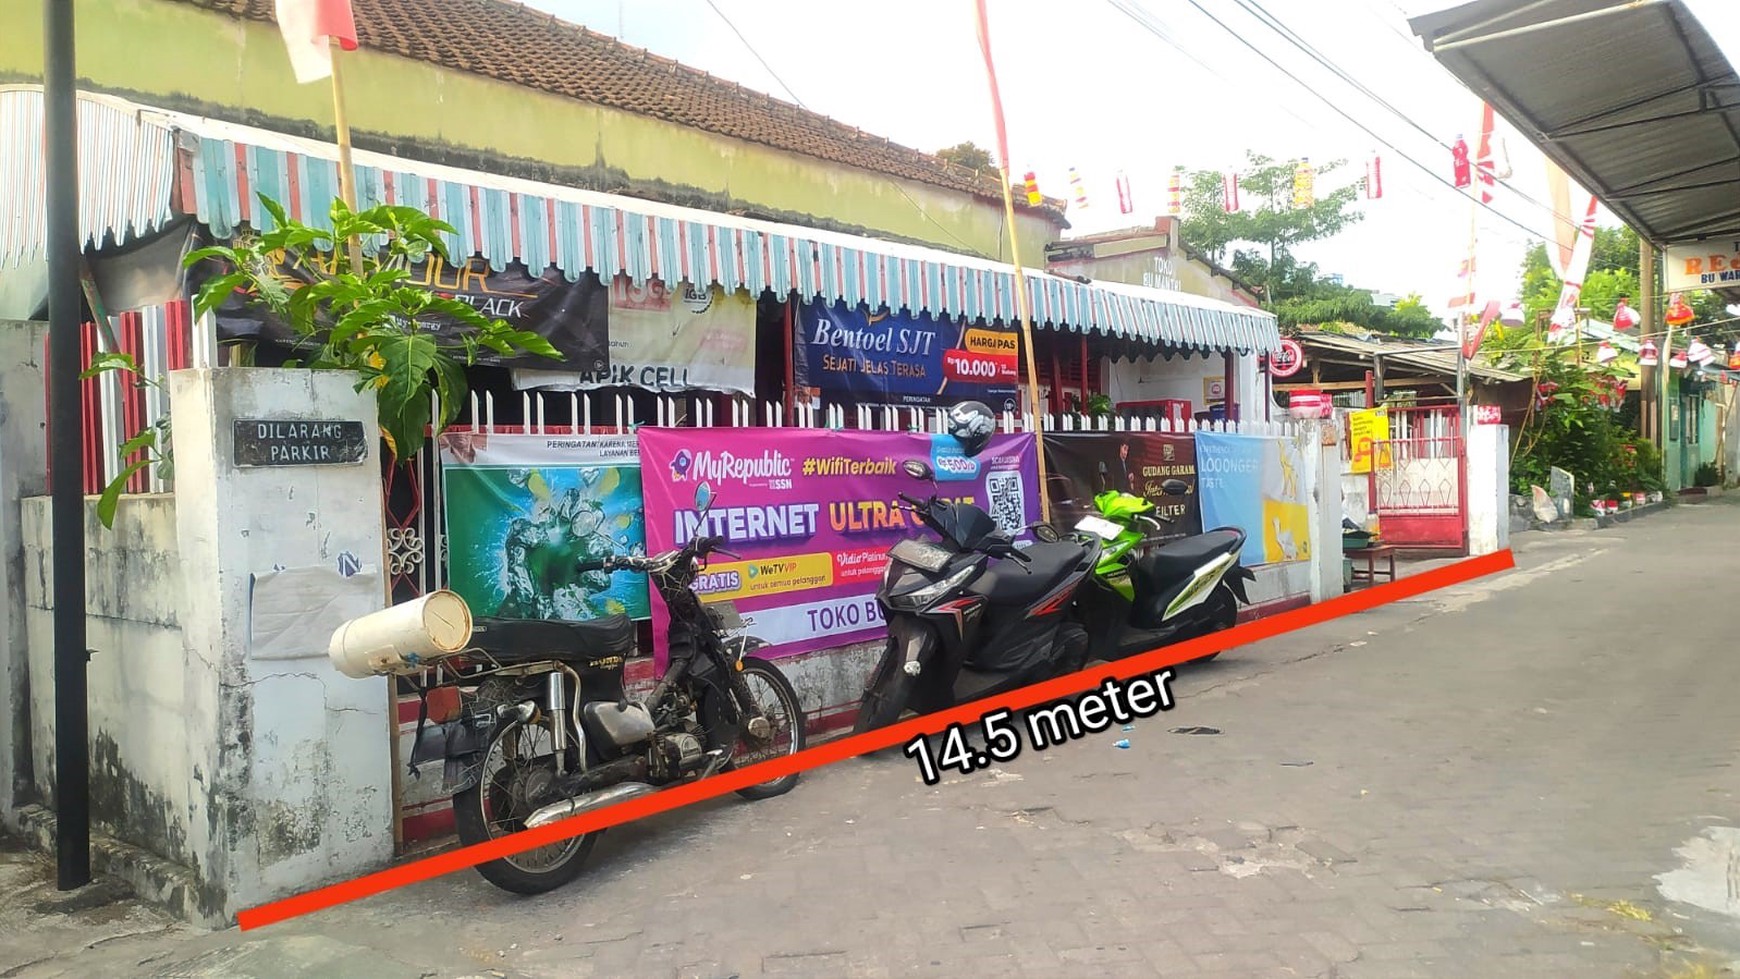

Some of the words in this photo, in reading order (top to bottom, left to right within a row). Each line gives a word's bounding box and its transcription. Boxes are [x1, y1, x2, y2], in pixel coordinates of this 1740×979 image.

[1153, 256, 1174, 276] TOKO
[1701, 273, 1715, 283] BU
[810, 318, 893, 352] Bentoel
[896, 328, 936, 355] SJT
[997, 340, 1016, 349] PAS
[823, 354, 857, 372] SEJATI
[860, 358, 889, 376] JELAS
[892, 360, 926, 377] TERASA
[257, 423, 342, 440] DILARANG
[271, 445, 331, 461] PARKIR
[692, 450, 792, 486] MyRepublic
[802, 456, 898, 477] #WifiTerbaik
[1142, 466, 1171, 478] GUDANG
[1171, 464, 1196, 475] GARAM
[1155, 504, 1186, 517] FILTER
[674, 503, 820, 545] INTERNET
[828, 499, 906, 532] ULTRA
[836, 551, 861, 567] Vidio
[689, 571, 740, 591] GRATIS
[807, 603, 860, 632] TOKO
